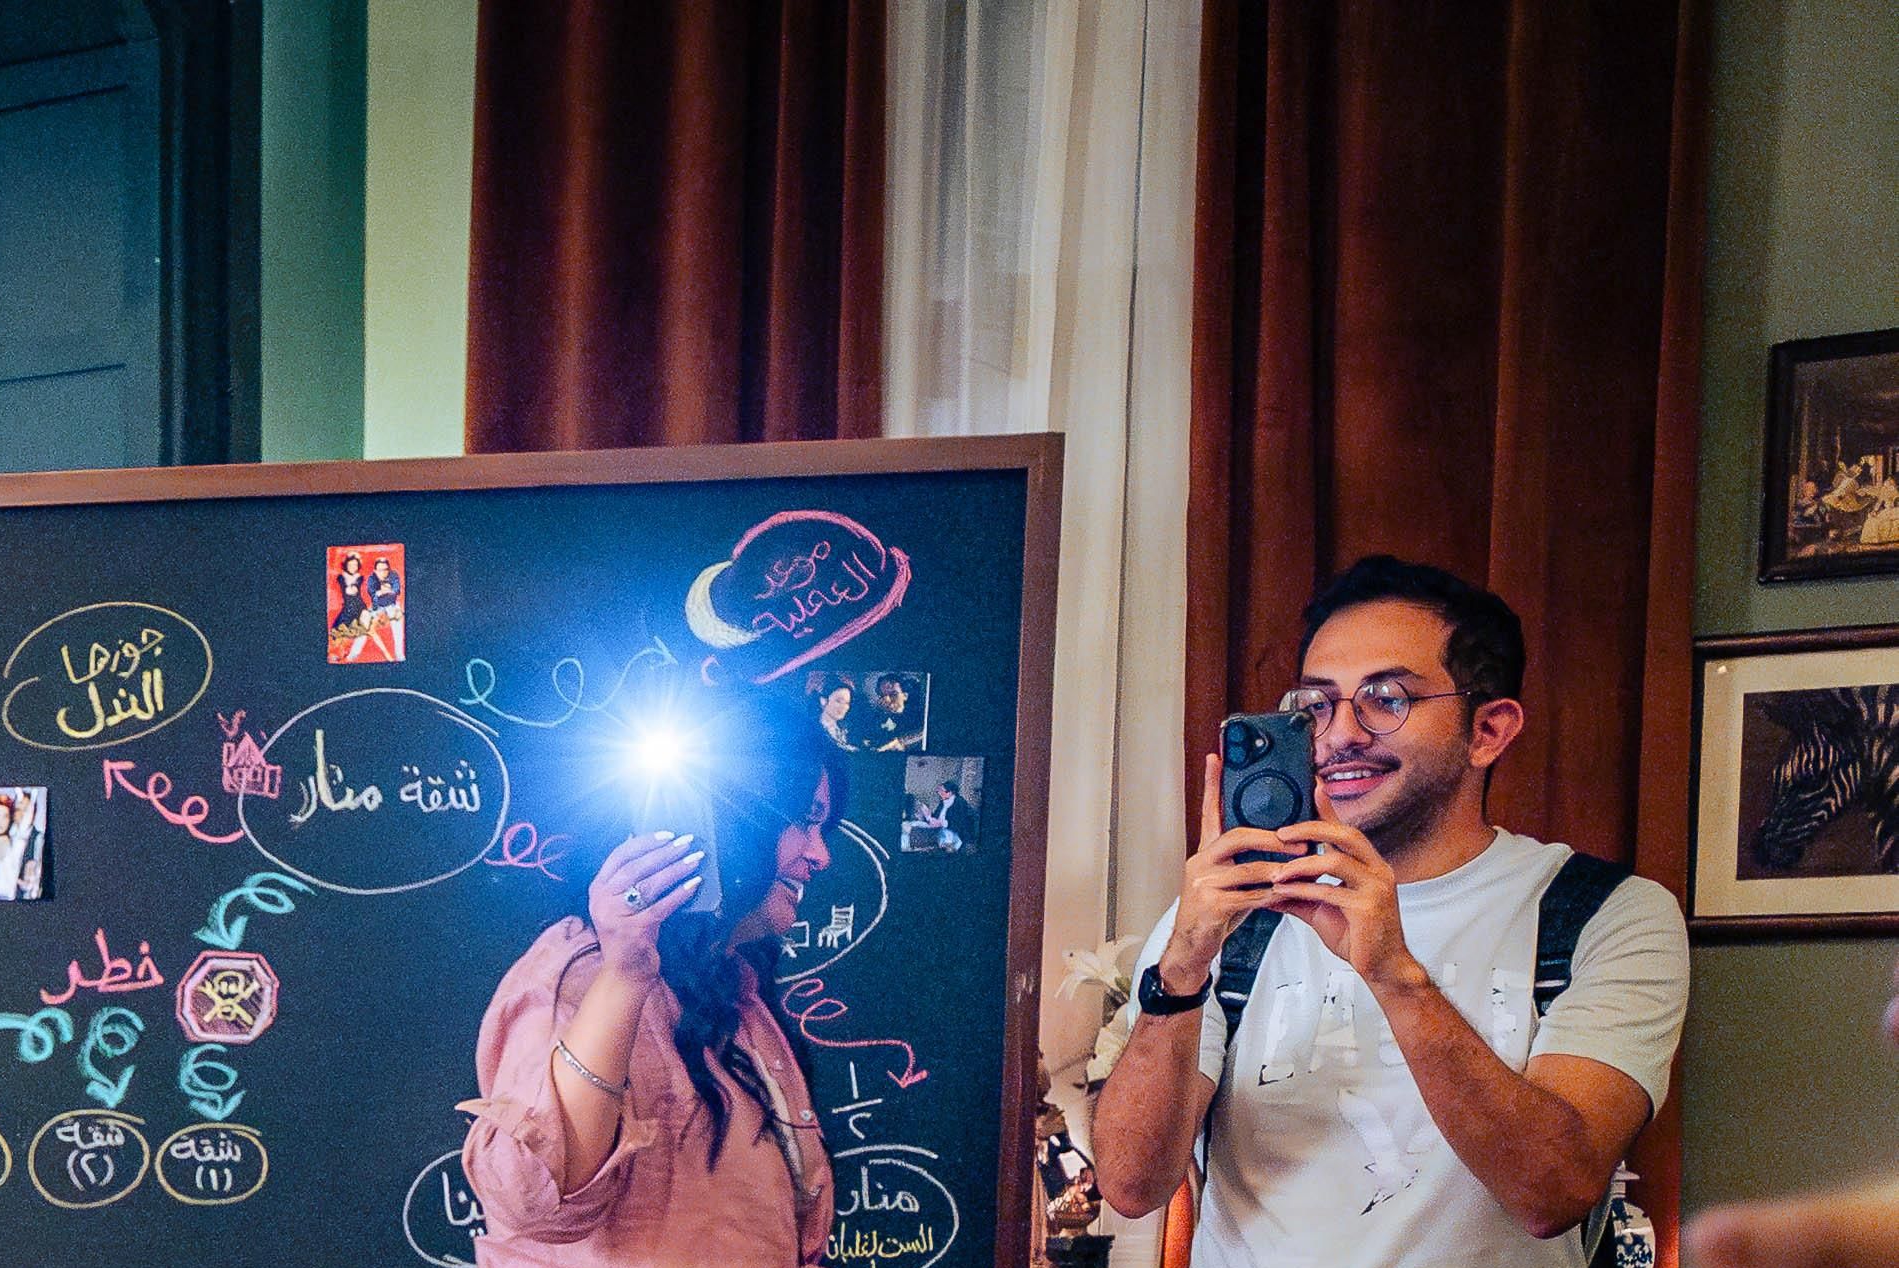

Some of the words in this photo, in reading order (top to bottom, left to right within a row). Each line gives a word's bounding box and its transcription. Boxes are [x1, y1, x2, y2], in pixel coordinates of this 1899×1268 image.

[61, 628, 165, 684] جوزها
[289, 729, 383, 826] منار
[400, 760, 480, 813] شقة
[40, 927, 165, 1005] خطر
[837, 1166, 919, 1216] منار
[878, 1223, 933, 1258] الست
